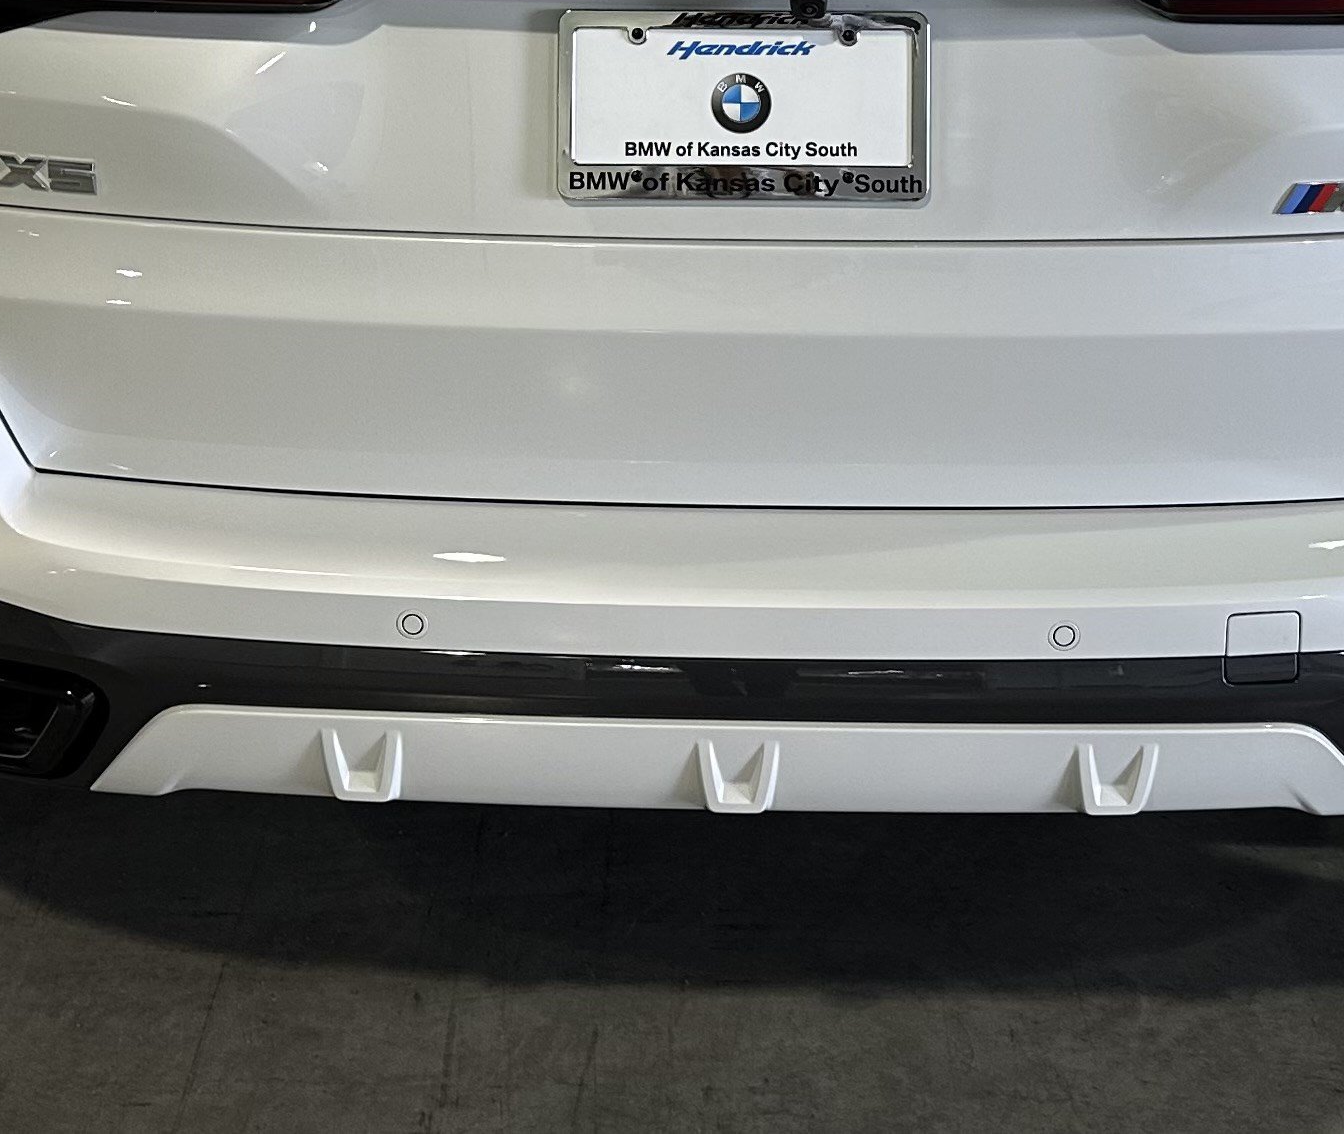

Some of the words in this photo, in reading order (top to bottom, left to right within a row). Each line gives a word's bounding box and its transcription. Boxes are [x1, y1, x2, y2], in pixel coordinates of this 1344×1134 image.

[666, 40, 817, 61] Hendrick
[717, 74, 765, 93] BMW
[624, 141, 672, 157] BMW
[675, 141, 694, 157] of
[697, 141, 761, 157] Kansas
[765, 141, 802, 161] City
[805, 141, 858, 157] South
[568, 171, 630, 190] BMW
[641, 172, 670, 191] of
[676, 172, 776, 192] Kansas
[783, 171, 840, 197] City
[854, 173, 923, 194] South
